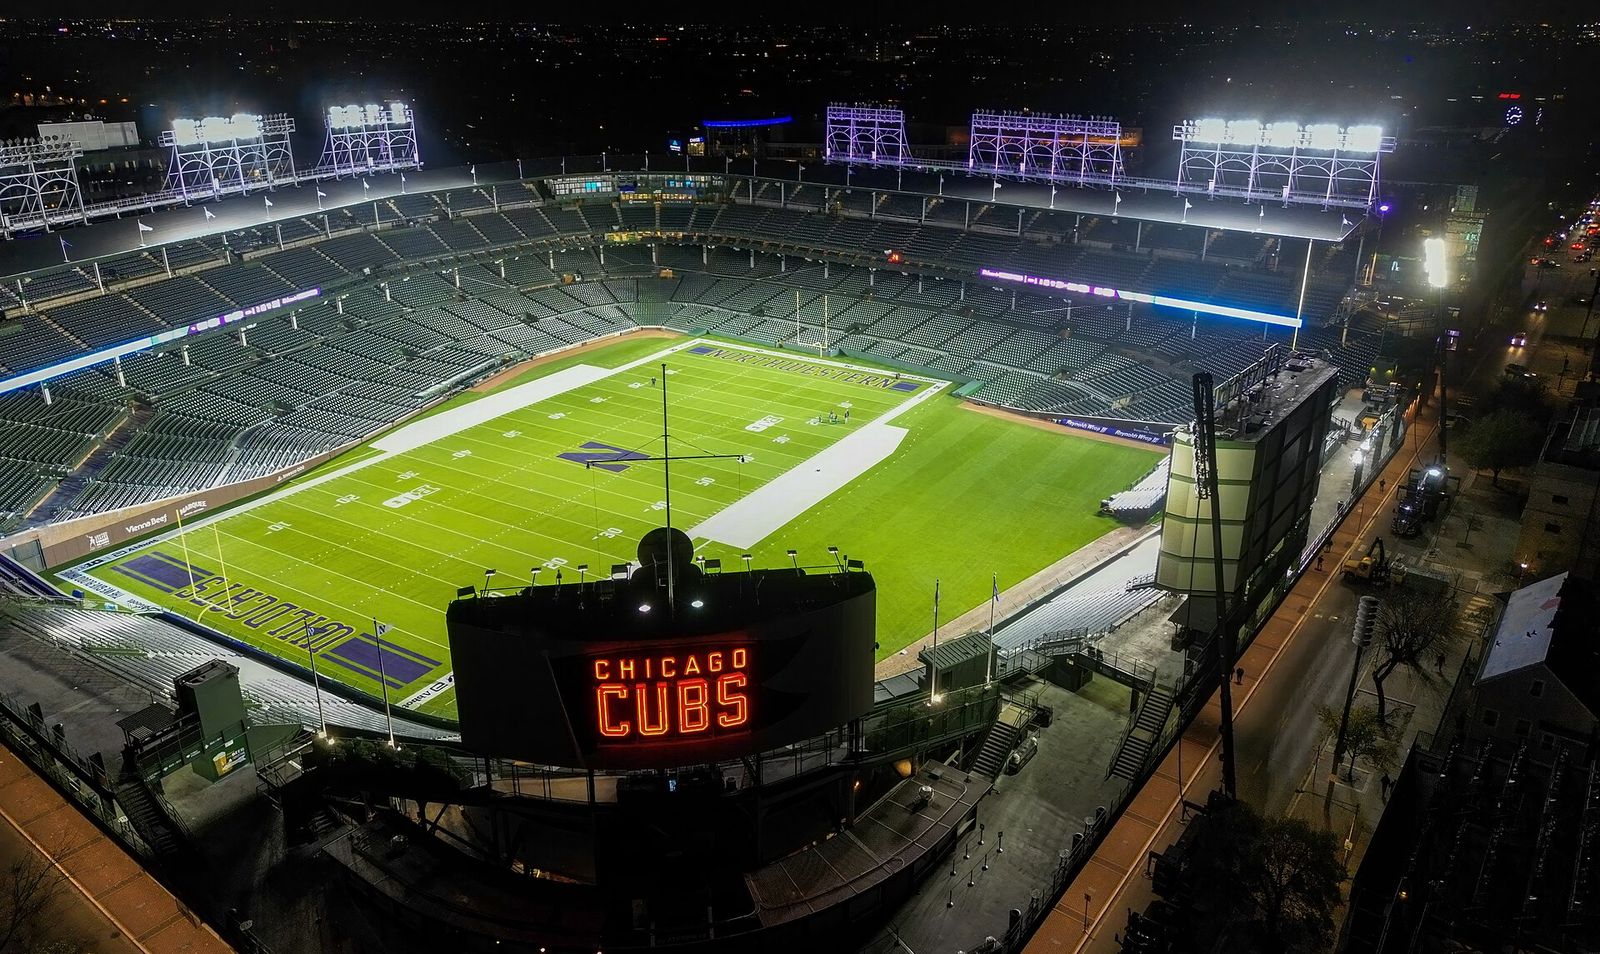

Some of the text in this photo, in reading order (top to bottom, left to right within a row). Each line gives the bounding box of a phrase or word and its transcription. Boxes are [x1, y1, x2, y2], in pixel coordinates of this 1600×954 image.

[703, 349, 897, 389] NORTHWESTERN
[180, 500, 207, 515] MARQUEE
[125, 514, 168, 533] Vienna Beef
[267, 521, 292, 532] 10
[175, 575, 356, 653] WILDCATS
[595, 649, 746, 680] CHICAGO
[401, 690, 431, 710] Abbot
[597, 672, 747, 736] CUBS
